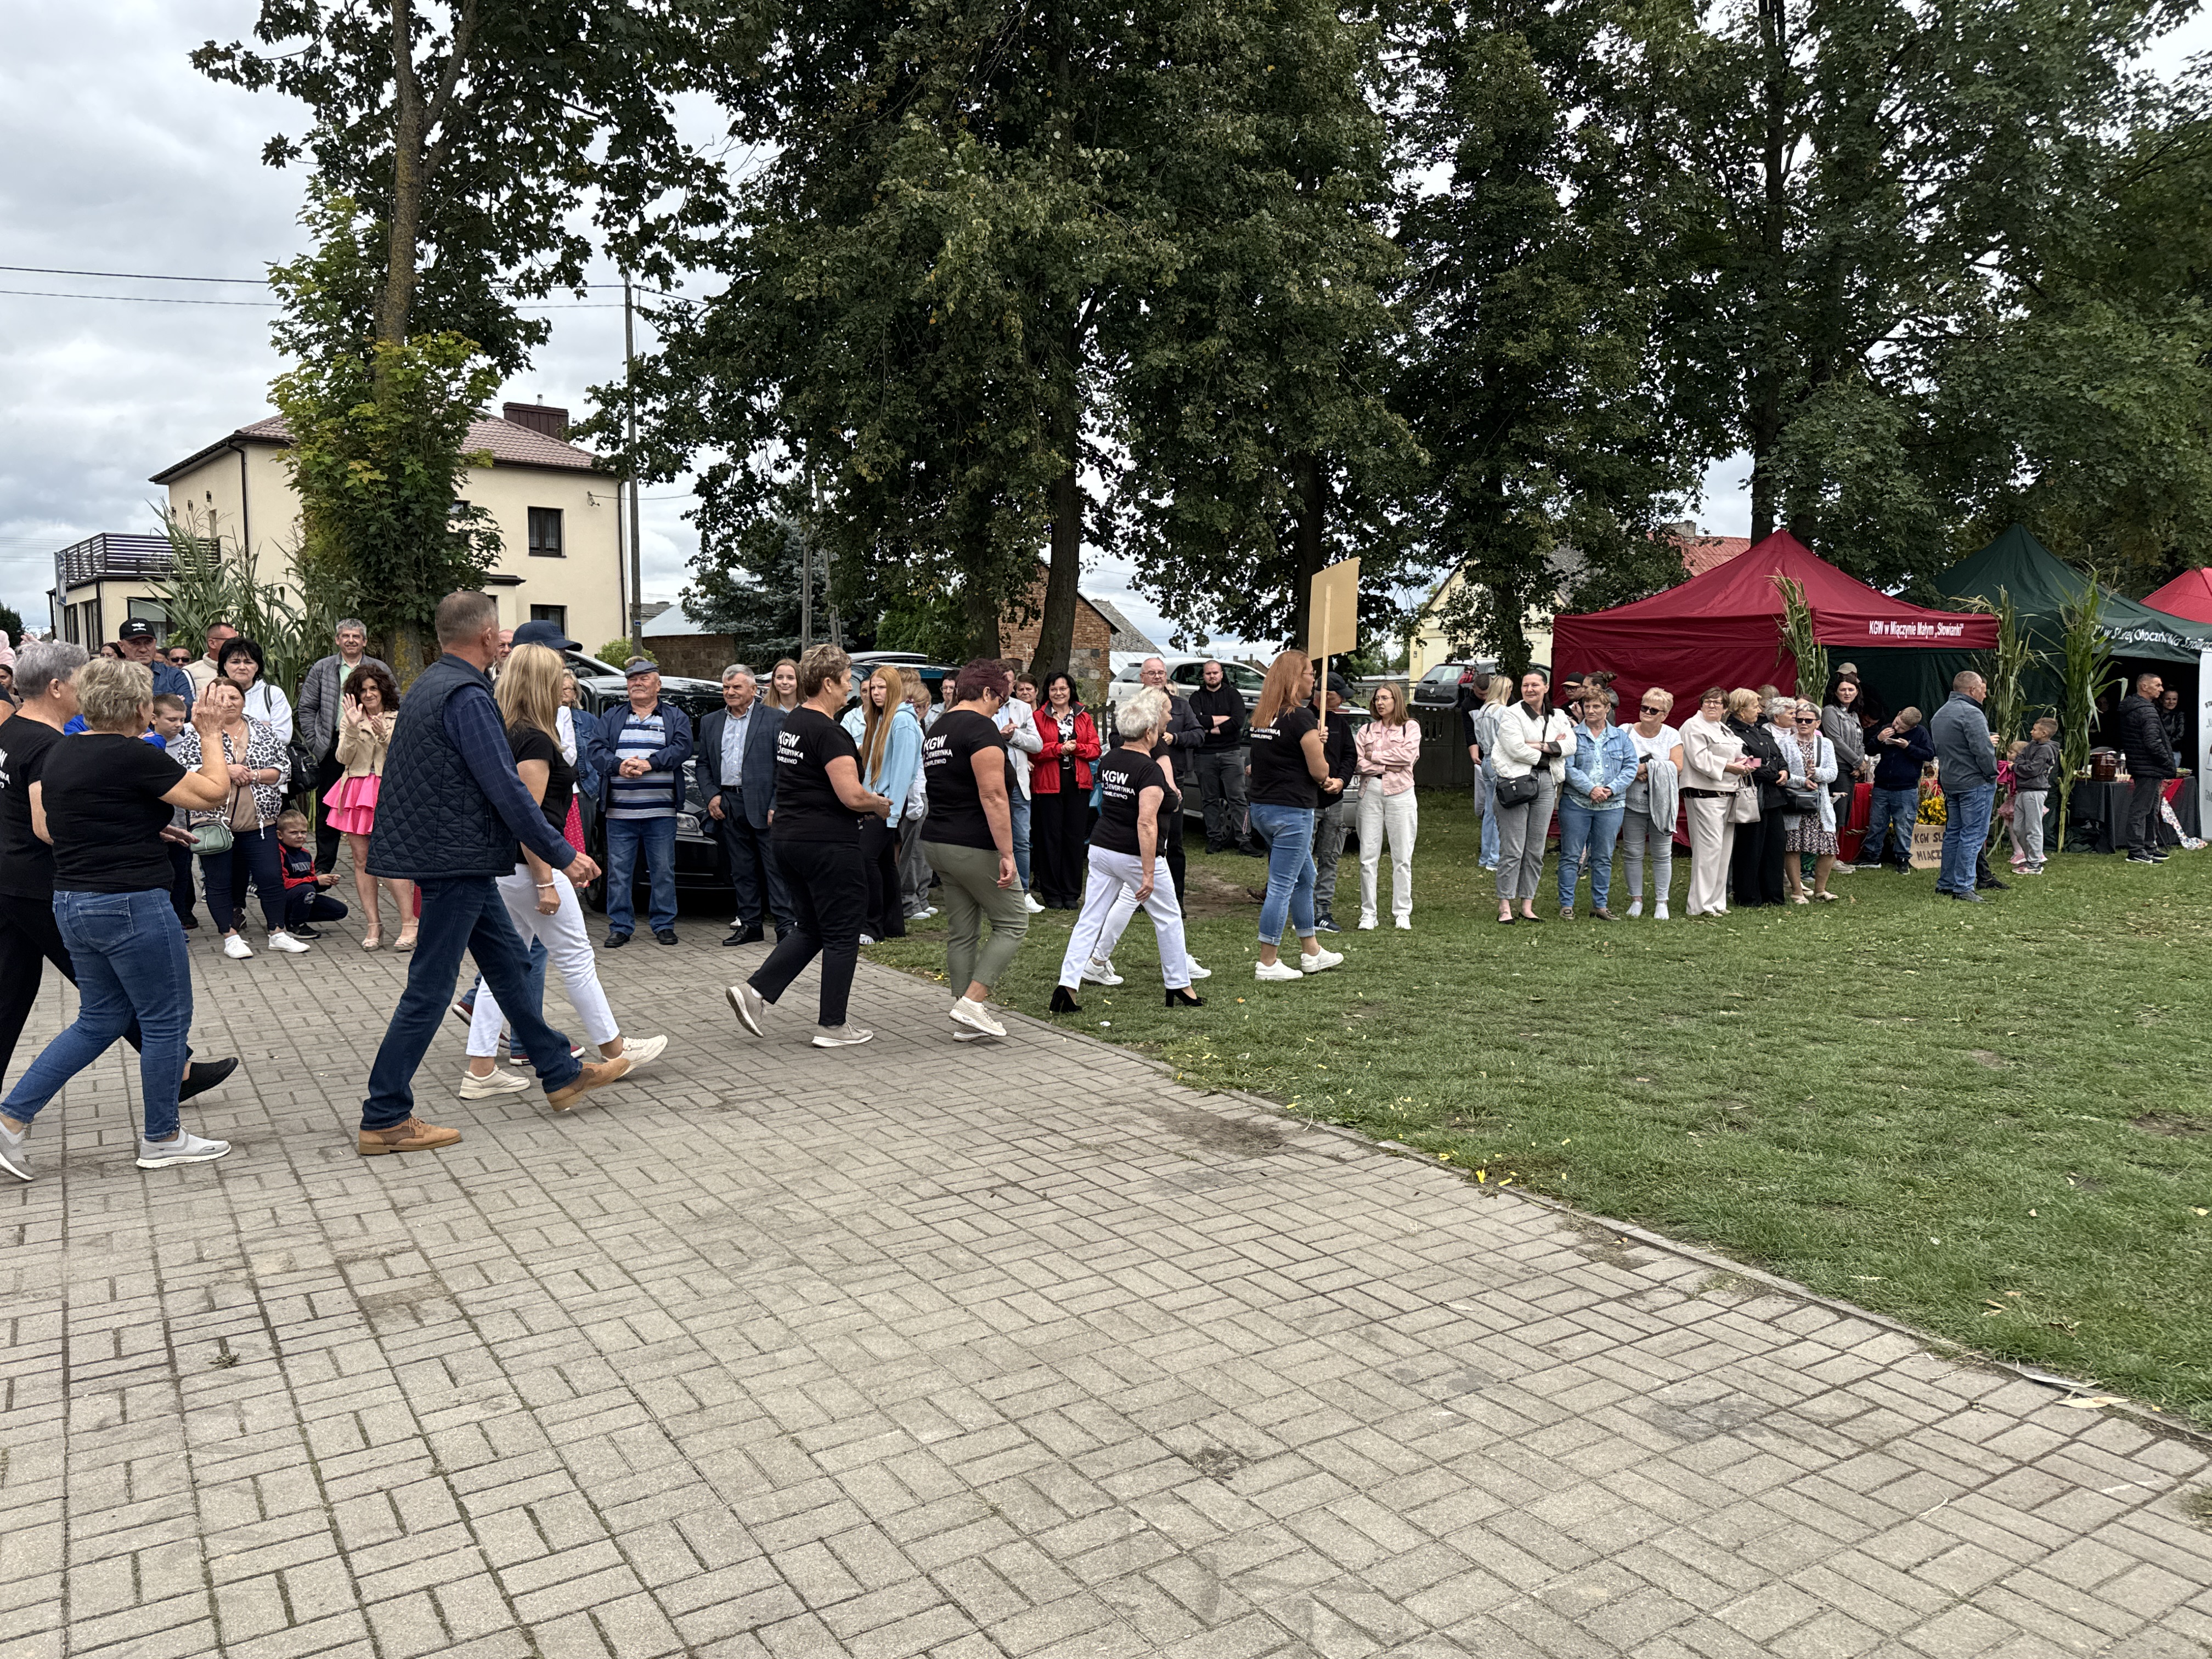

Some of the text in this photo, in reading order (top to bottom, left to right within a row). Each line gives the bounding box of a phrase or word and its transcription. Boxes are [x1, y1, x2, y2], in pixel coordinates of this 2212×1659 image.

[1869, 620, 1884, 635] KGW
[1884, 624, 1889, 635] w
[1890, 620, 1916, 639] Miączynie
[1917, 622, 1934, 639] Małym
[777, 731, 800, 747] KGW
[923, 735, 947, 752] KGW
[1102, 770, 1128, 785] KGW
[1916, 850, 1942, 861] MIĄCZ
